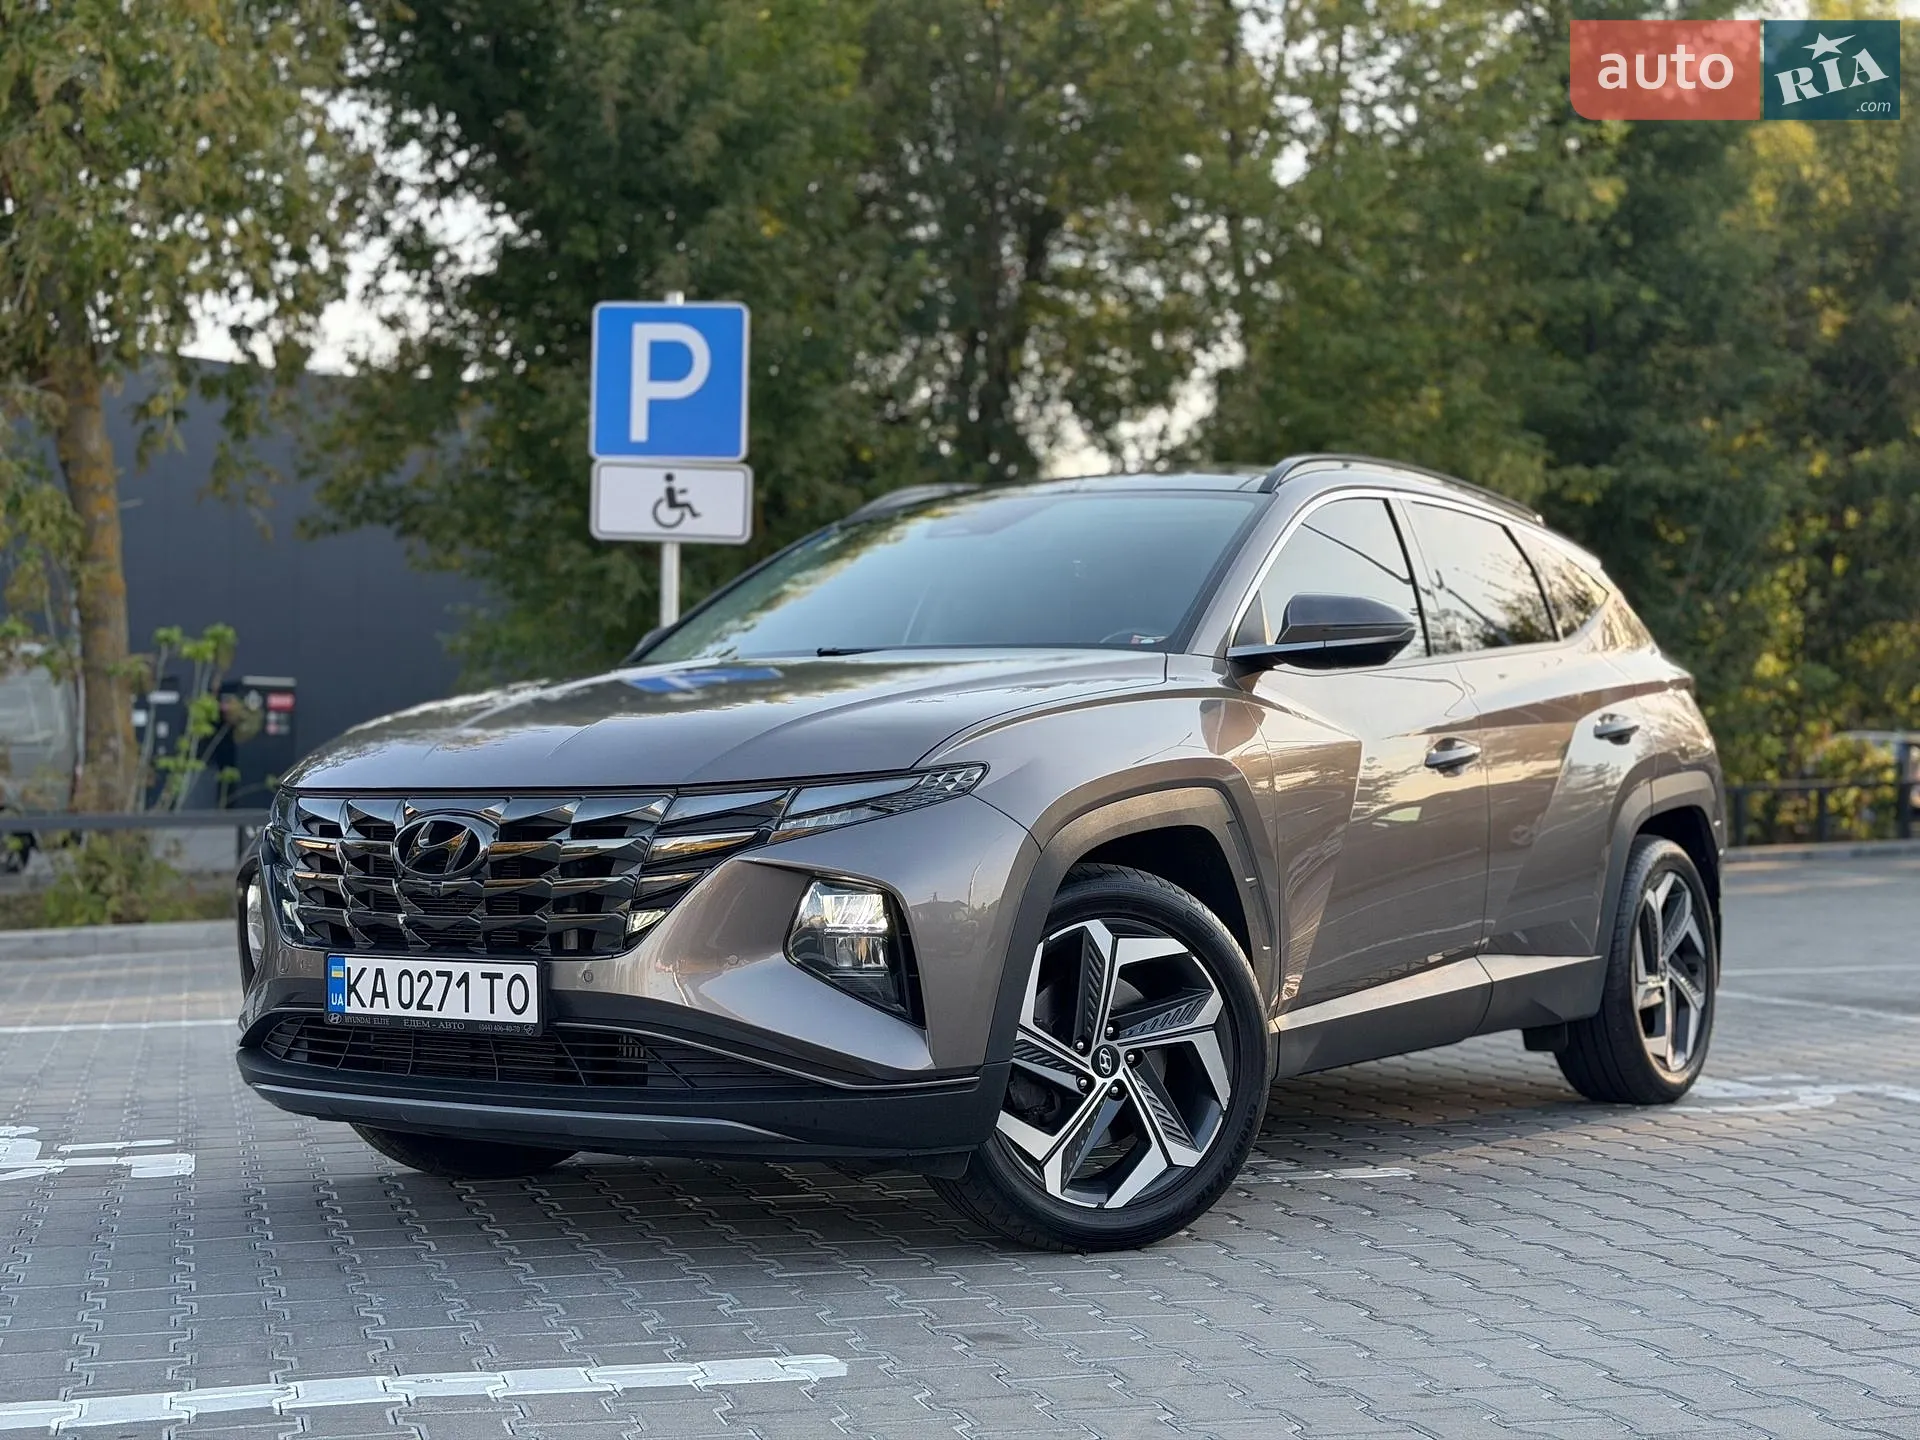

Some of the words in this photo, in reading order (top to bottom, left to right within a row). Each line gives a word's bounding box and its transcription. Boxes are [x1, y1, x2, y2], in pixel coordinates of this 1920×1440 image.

[629, 322, 711, 443] P
[331, 992, 344, 1006] UA
[346, 966, 390, 1009] KA
[397, 968, 470, 1014] 0271
[480, 971, 530, 1016] TO
